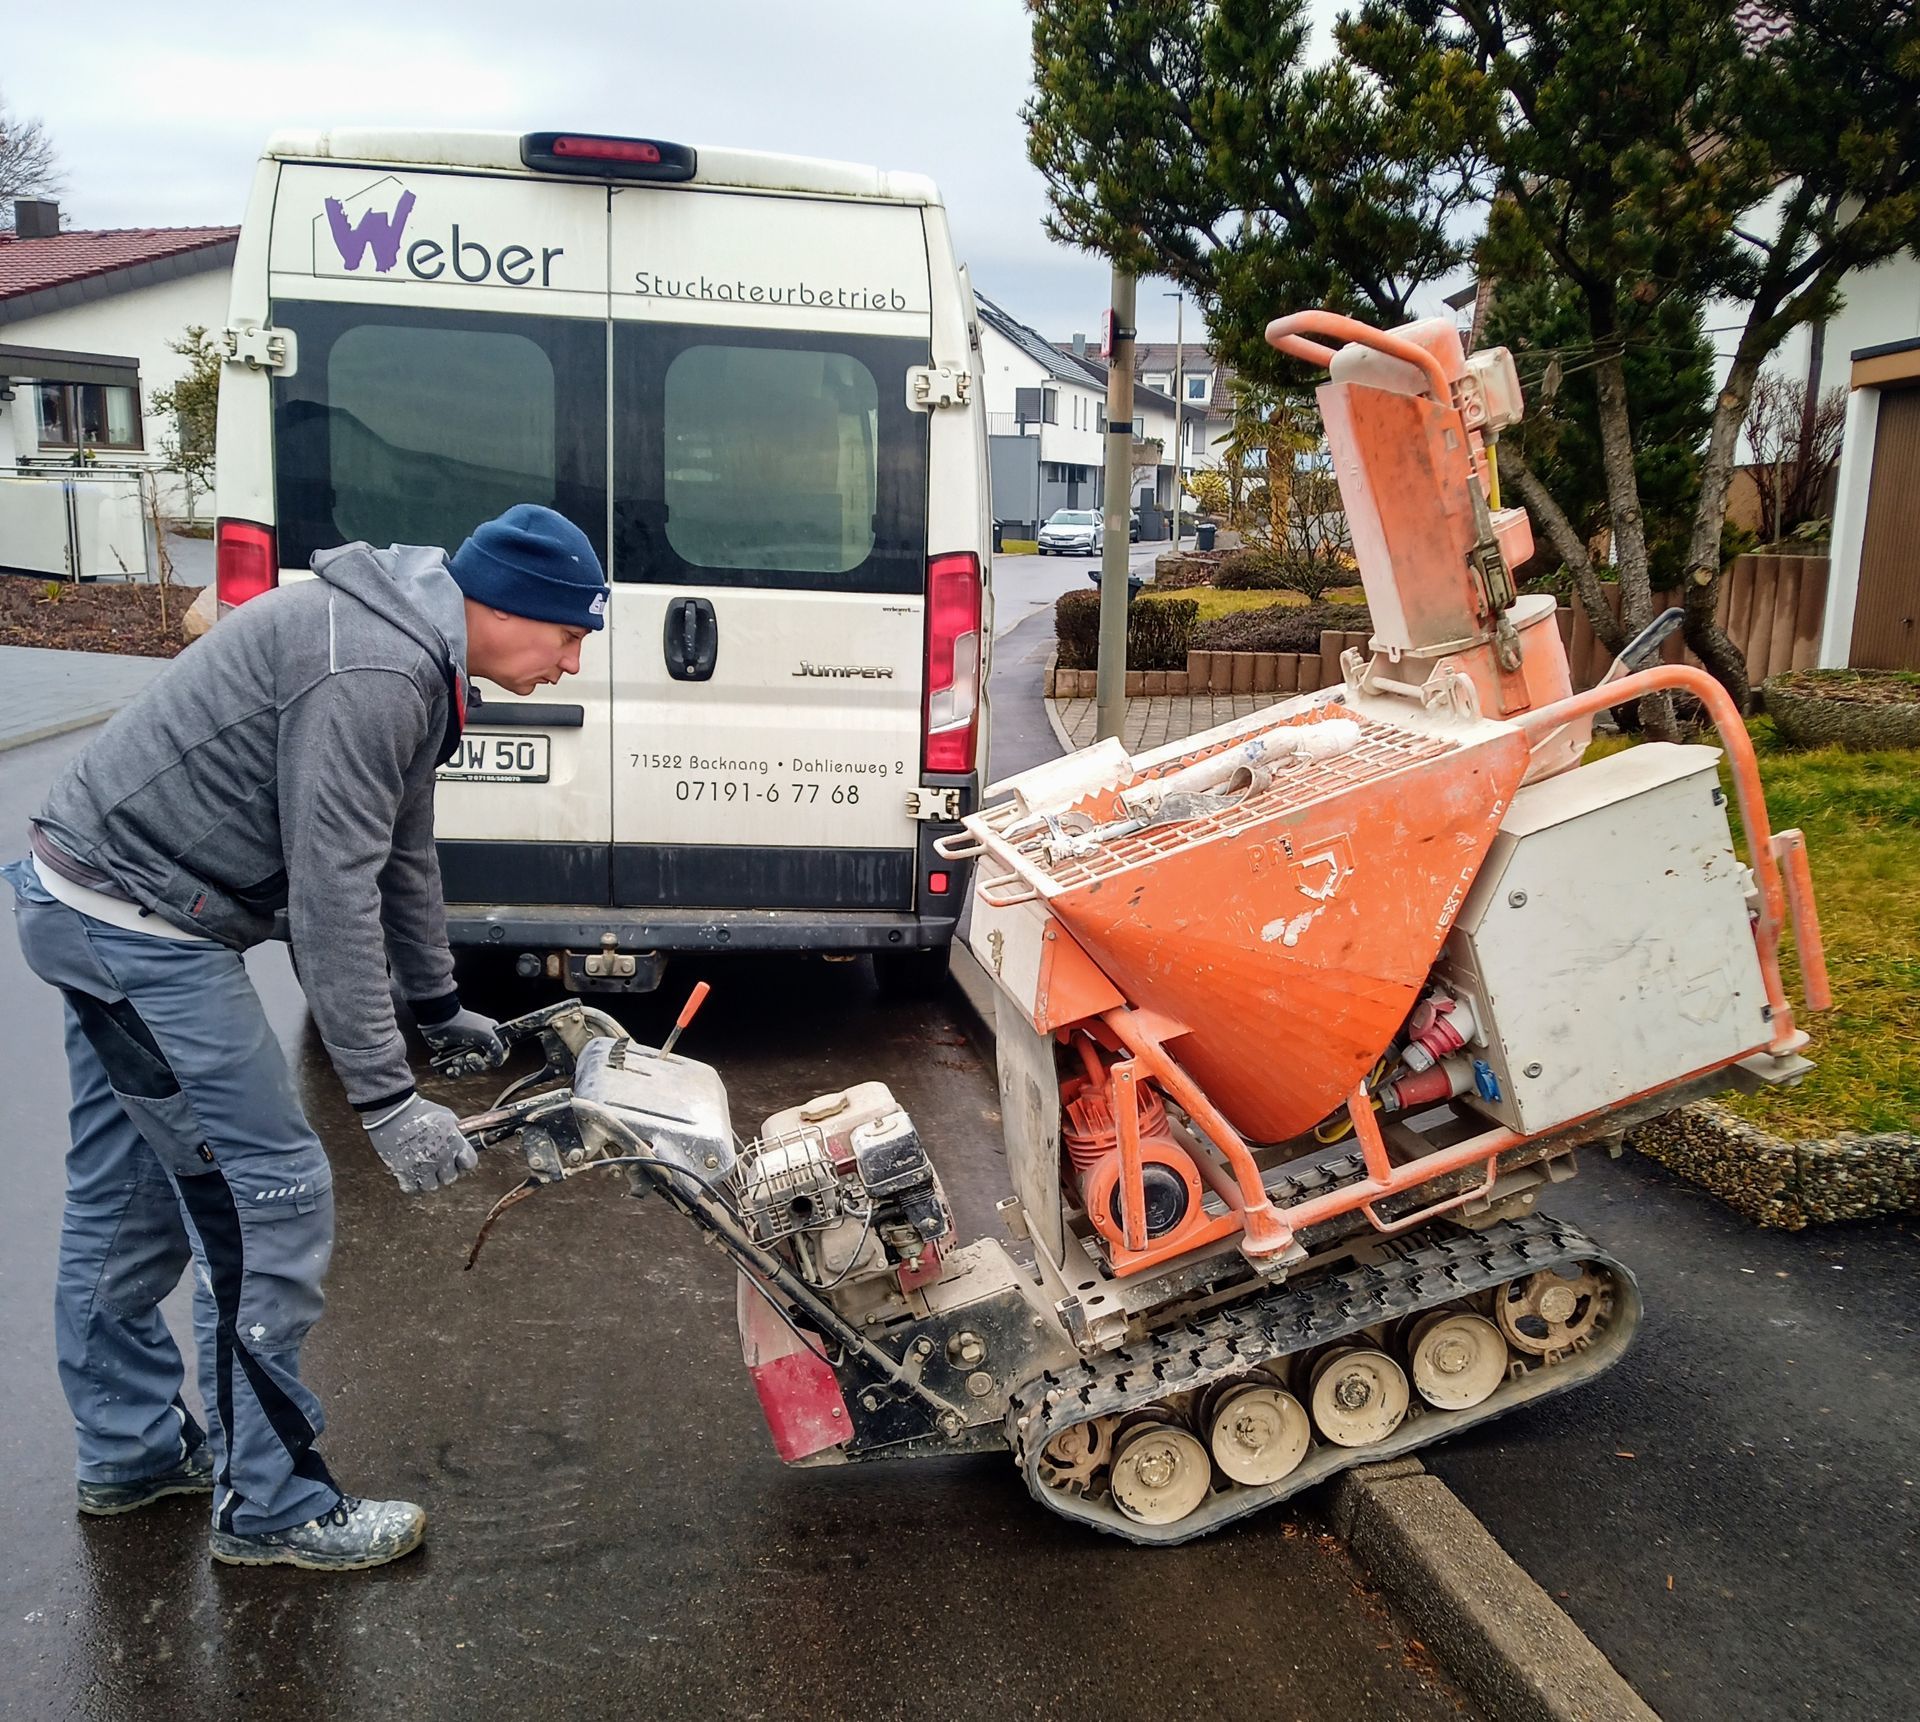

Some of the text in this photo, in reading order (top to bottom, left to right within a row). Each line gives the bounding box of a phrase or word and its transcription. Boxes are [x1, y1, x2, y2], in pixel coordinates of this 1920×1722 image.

[324, 189, 564, 287] Weber
[635, 271, 907, 312] Stuckateurbetrieb
[495, 741, 535, 771] 50
[630, 753, 904, 778] 71522 Backnang Dahlienweg 2
[676, 780, 860, 805] 07191-6 77 68
